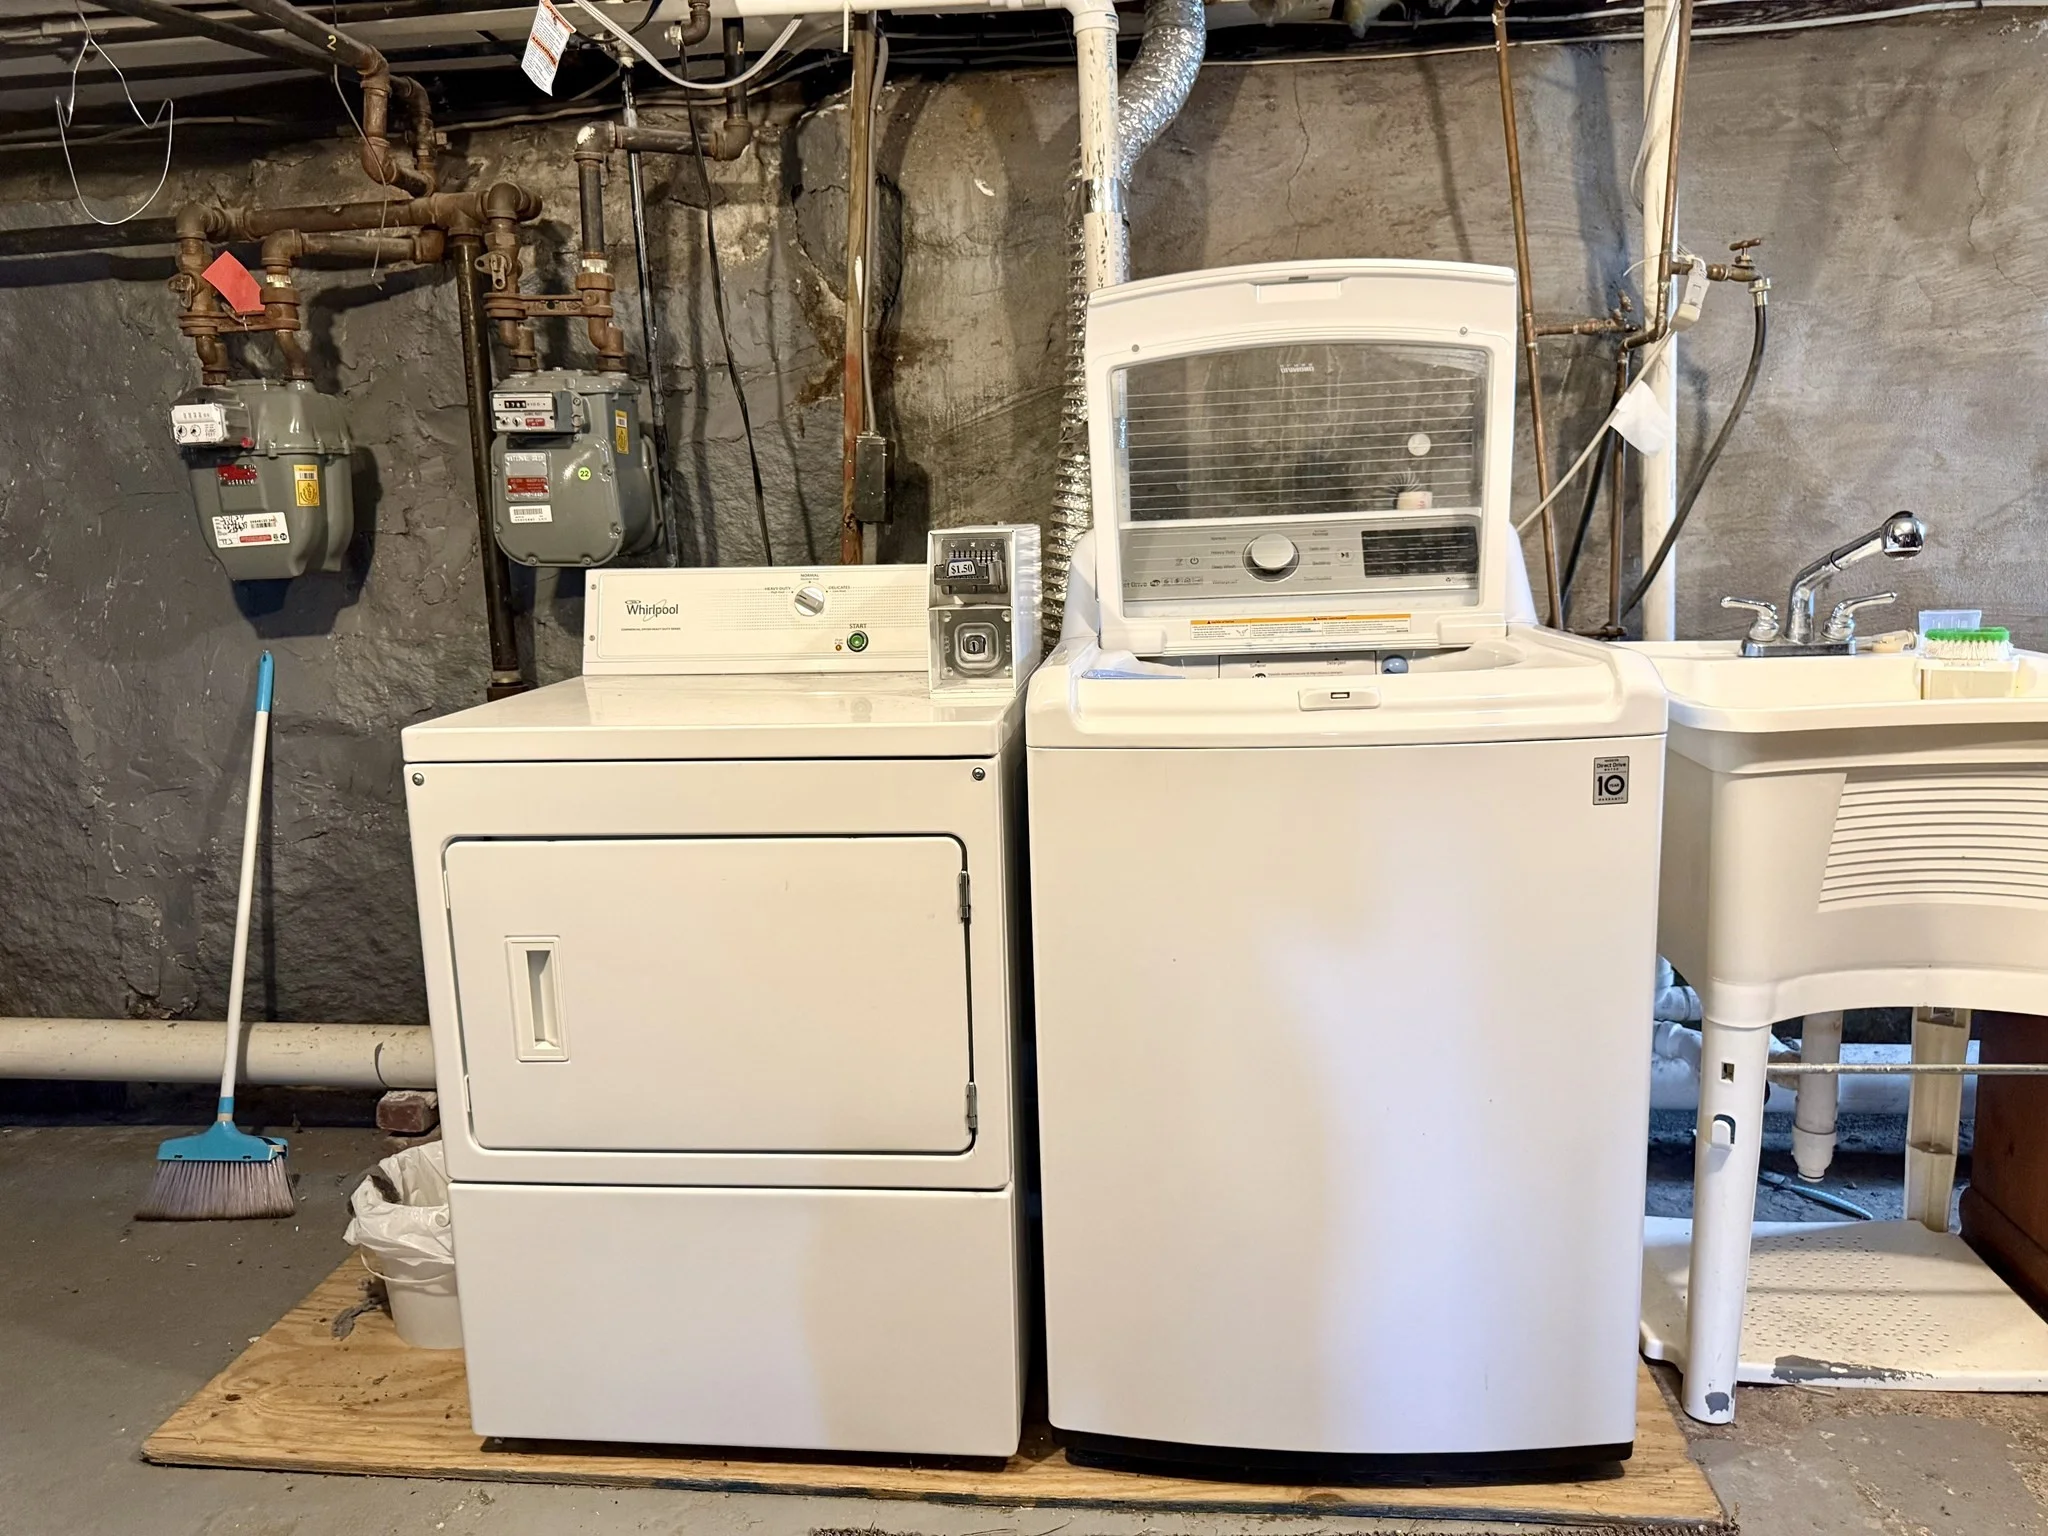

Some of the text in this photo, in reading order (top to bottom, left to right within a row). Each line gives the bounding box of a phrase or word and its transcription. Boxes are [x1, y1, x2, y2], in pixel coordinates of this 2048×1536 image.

[327, 34, 337, 51] 2
[950, 564, 972, 574] $1.50
[626, 604, 678, 617] Whirlpool
[1597, 775, 1625, 796] 10
